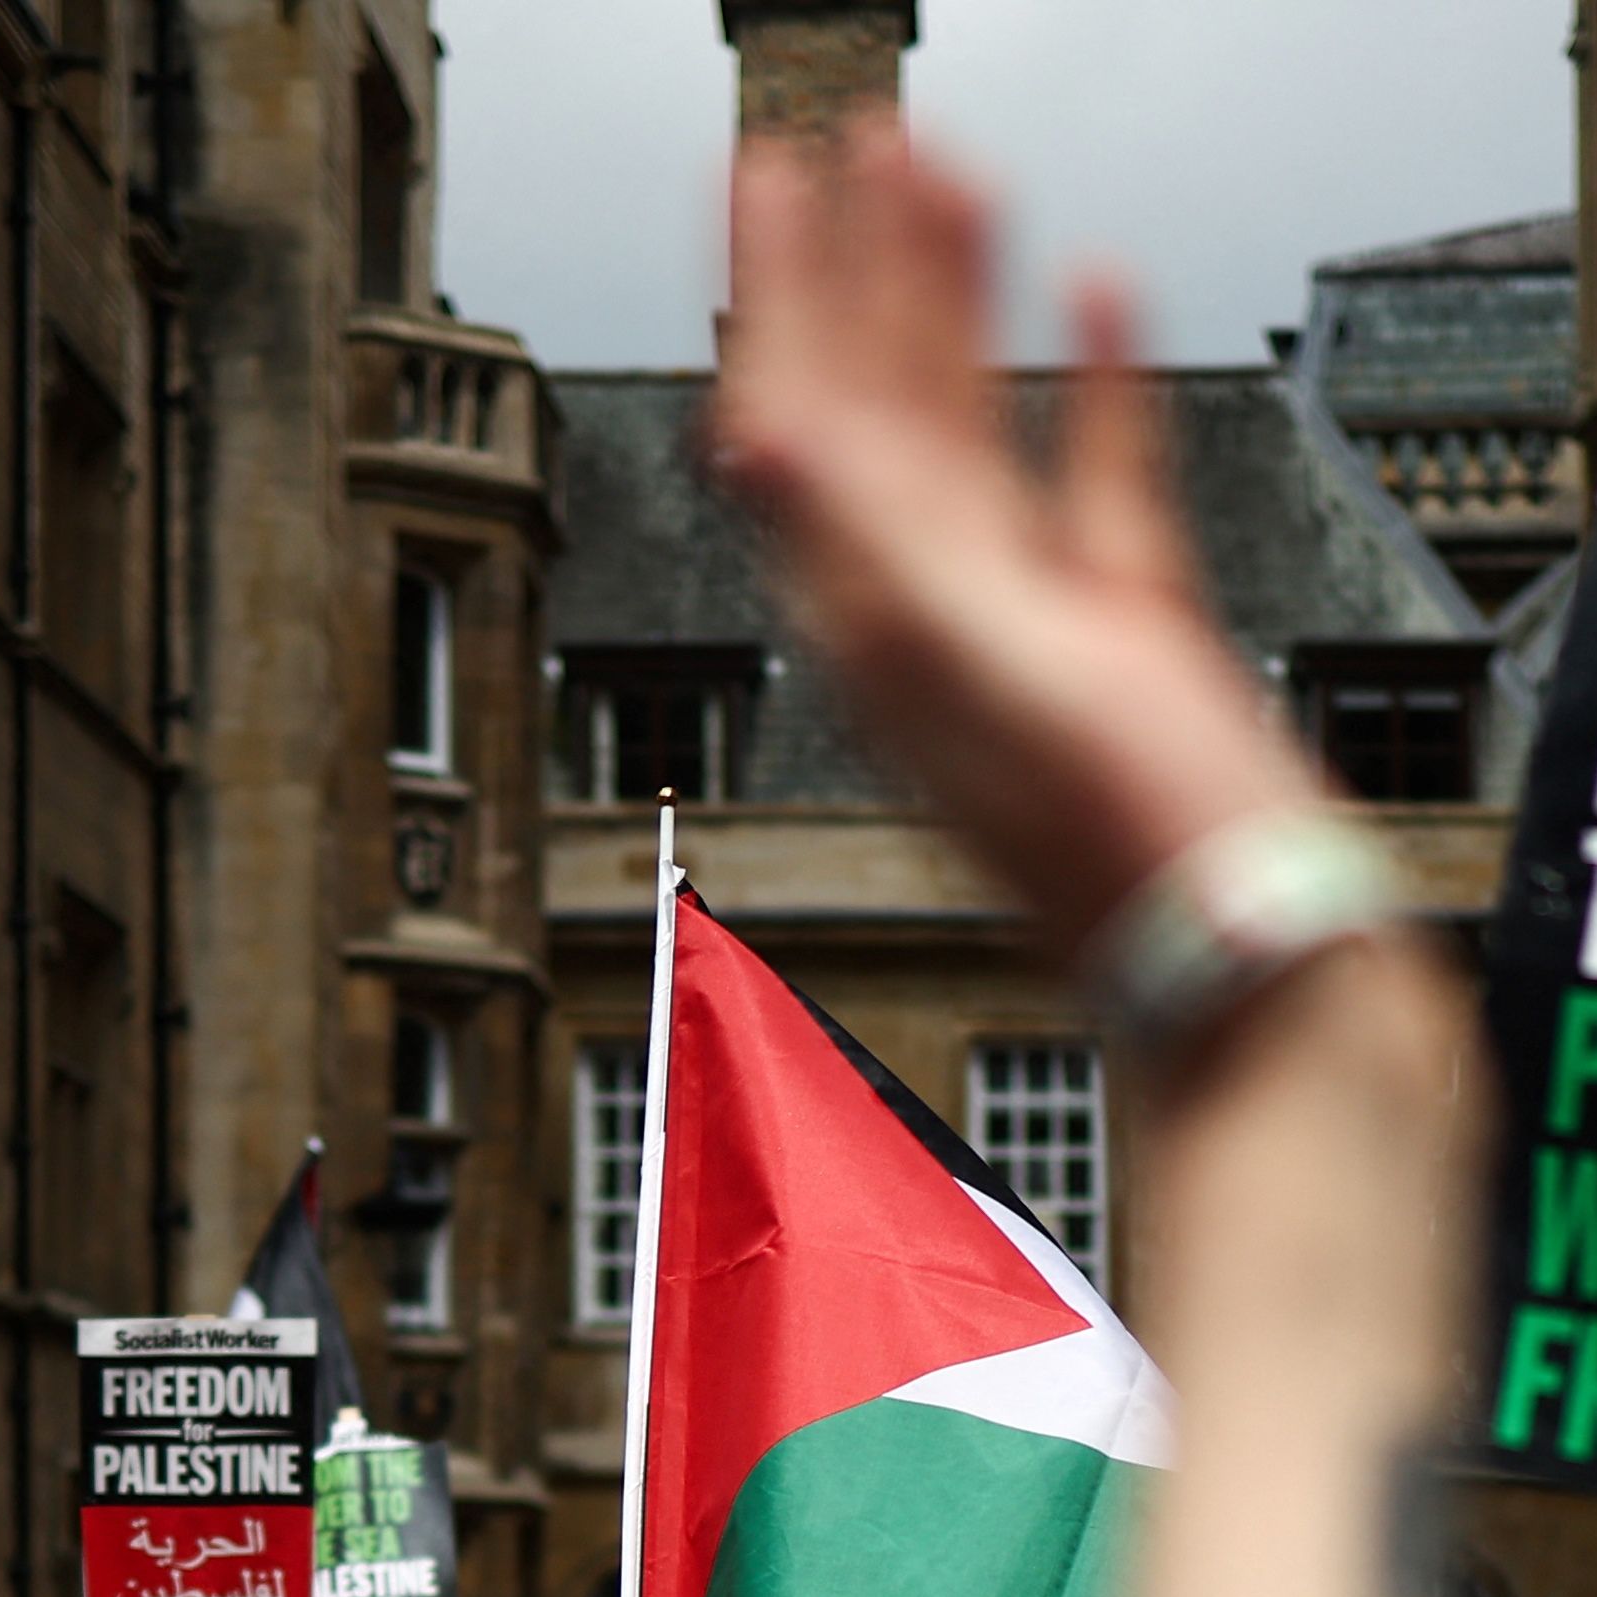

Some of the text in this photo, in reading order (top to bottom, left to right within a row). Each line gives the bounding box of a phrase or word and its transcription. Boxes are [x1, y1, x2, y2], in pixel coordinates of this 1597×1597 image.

[114, 1329, 280, 1352] Socialist Worker
[102, 1366, 291, 1417] FREEDOM
[180, 1418, 215, 1442] for
[93, 1444, 302, 1496] PALESTINE
[366, 1449, 424, 1487] THE
[371, 1488, 412, 1525] TO
[127, 1516, 267, 1569] الحرية
[343, 1526, 401, 1564] SEA
